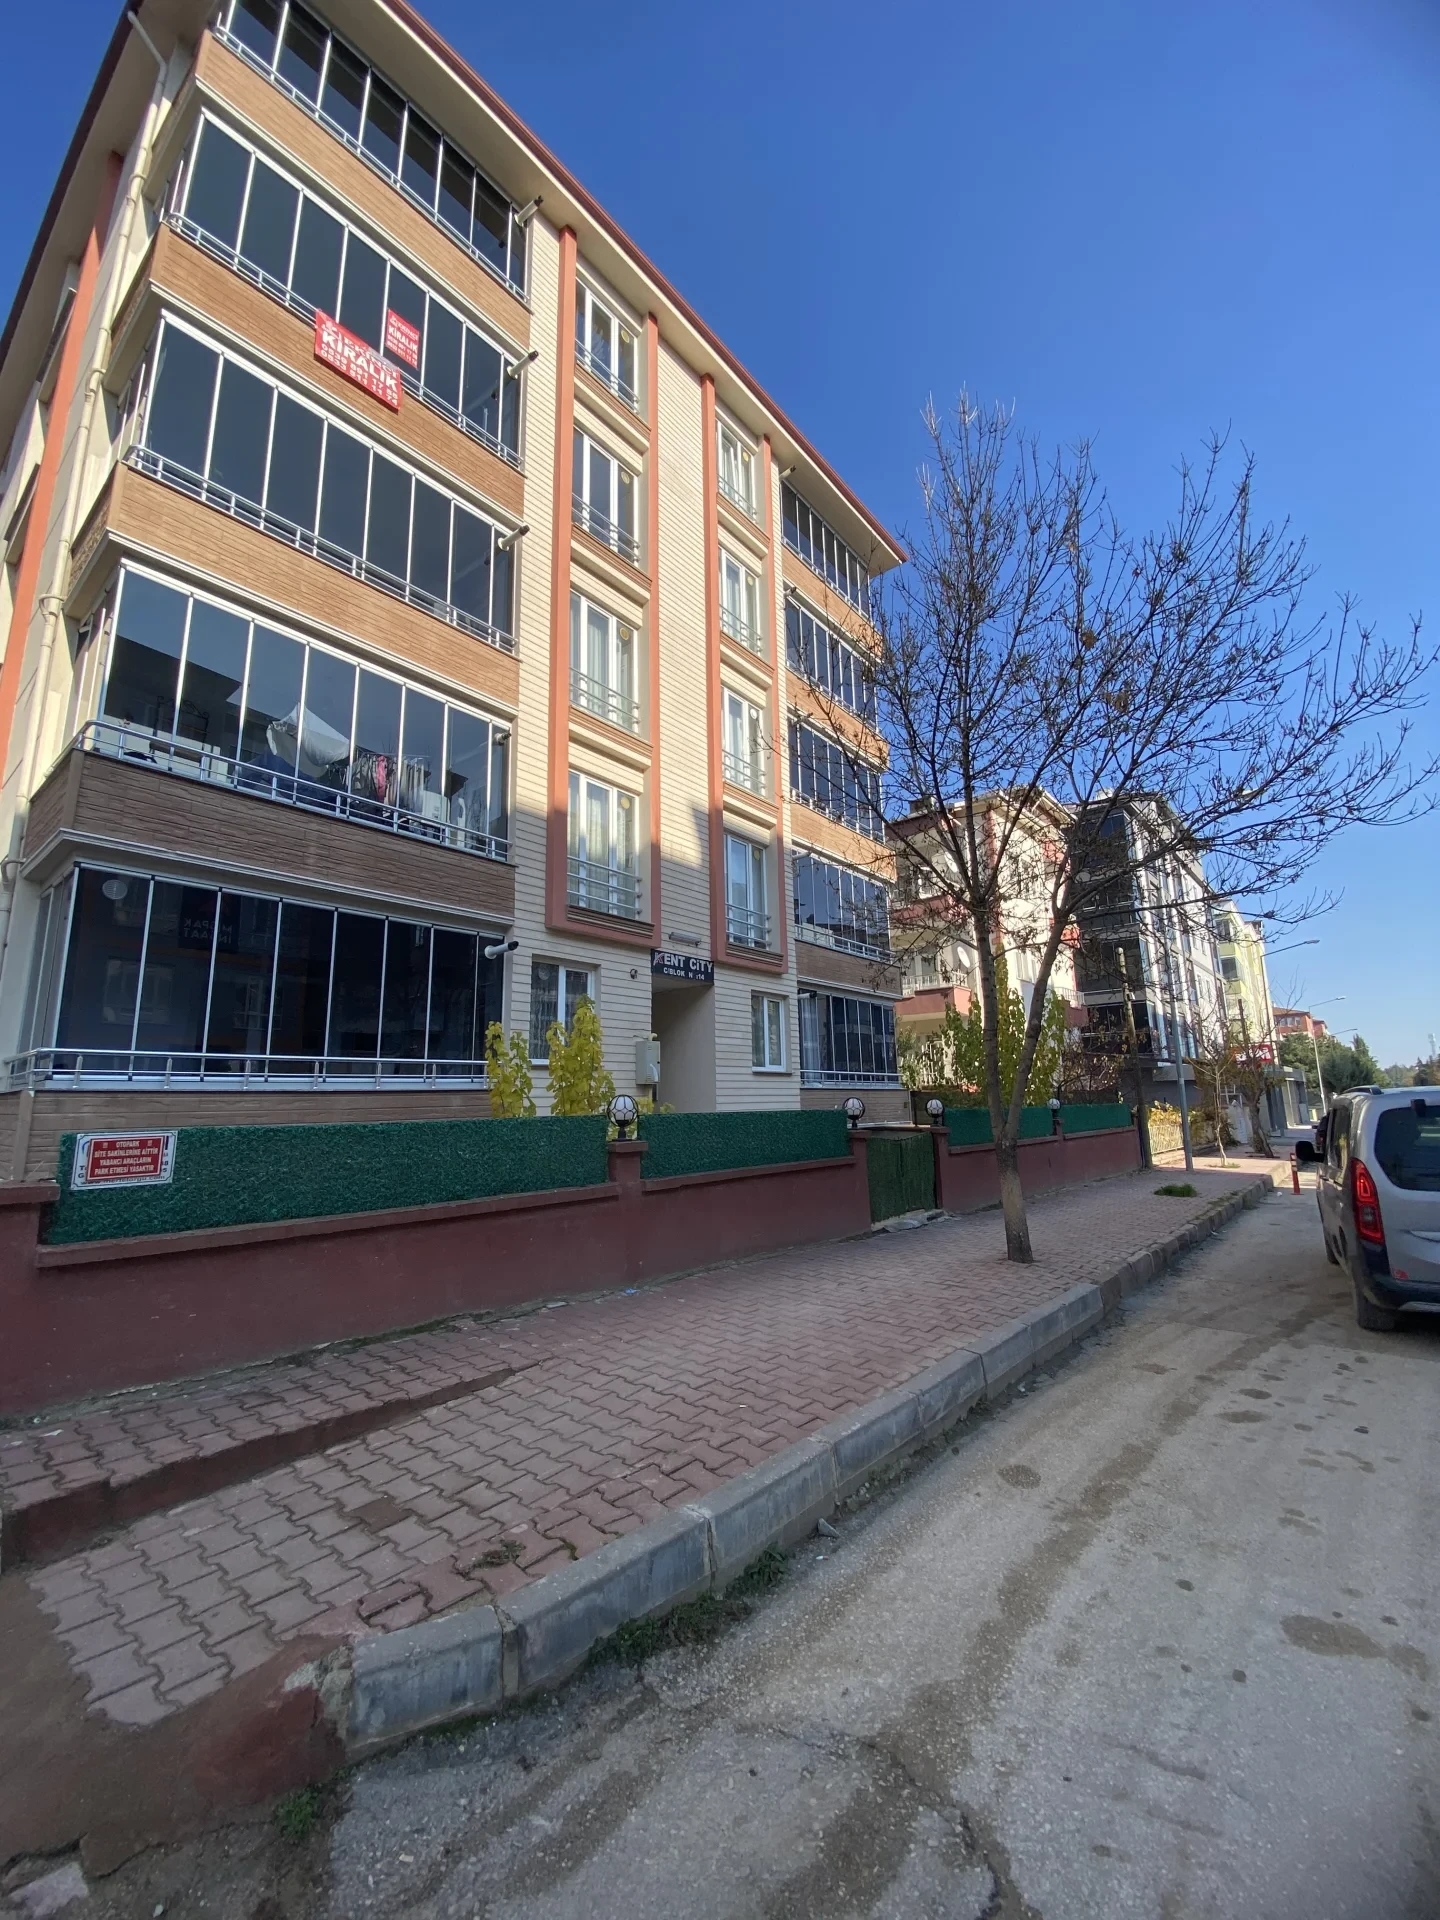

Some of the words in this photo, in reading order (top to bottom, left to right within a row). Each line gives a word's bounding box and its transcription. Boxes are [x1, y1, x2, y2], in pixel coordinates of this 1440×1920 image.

[321, 344, 347, 364] 0539
[350, 363, 368, 379] 891
[372, 378, 383, 388] 17
[321, 350, 347, 370] 0533
[350, 370, 368, 385] 511
[372, 385, 383, 396] 11
[386, 395, 398, 406] 74
[653, 952, 685, 967] KENT
[94, 1149, 106, 1158] SİTE
[107, 1148, 141, 1157] SAKİNLERİNE
[123, 1157, 152, 1165] ARAÇLARIN
